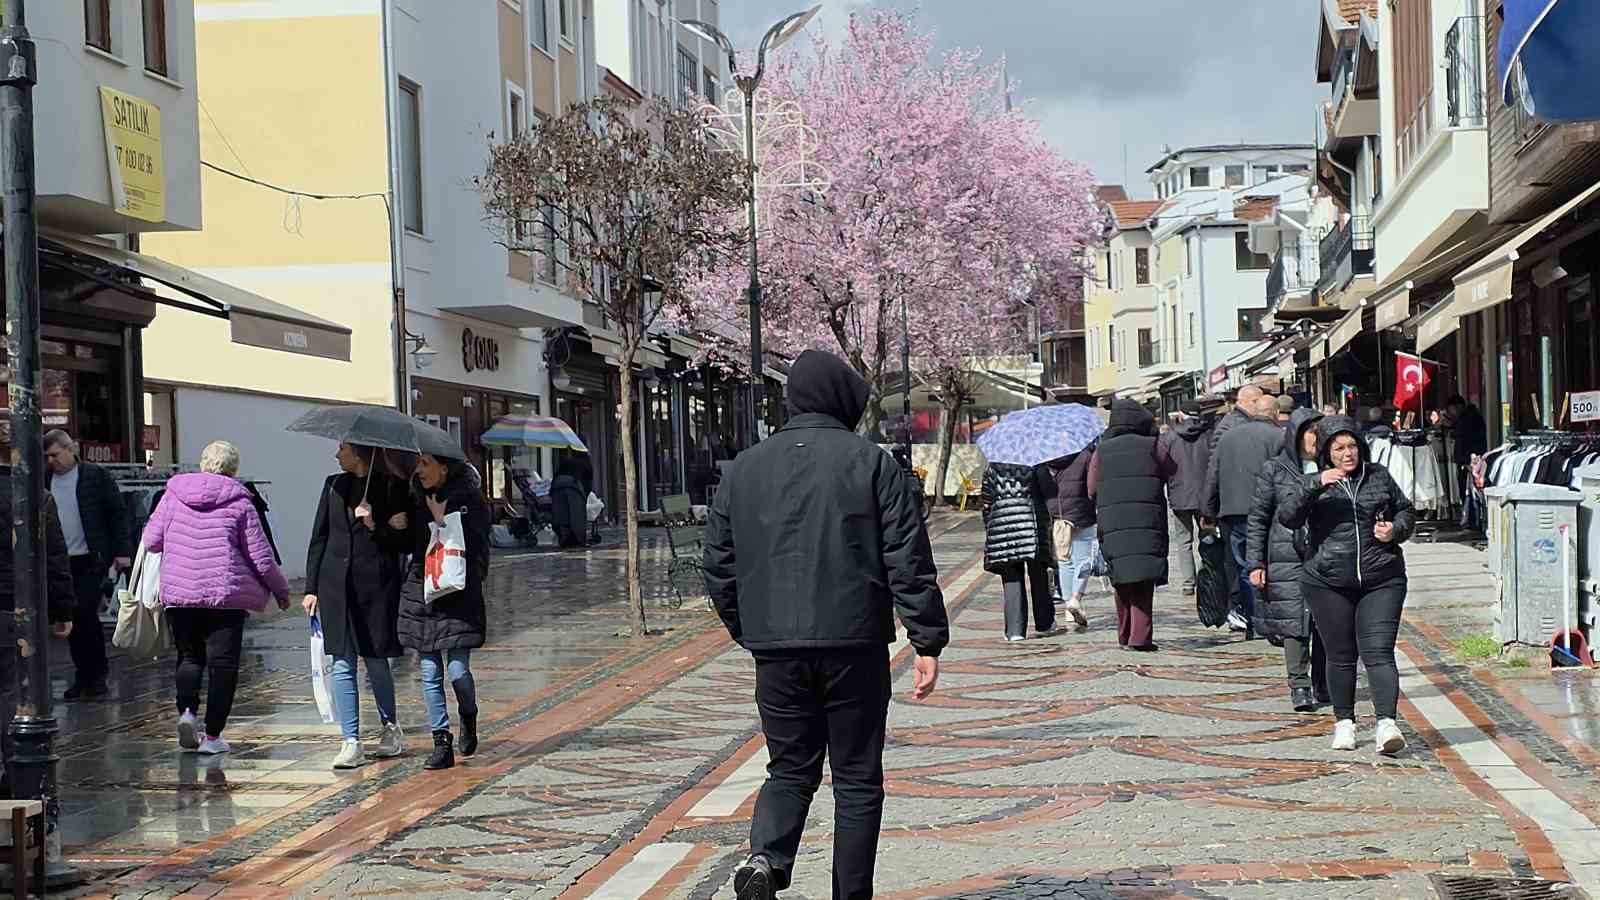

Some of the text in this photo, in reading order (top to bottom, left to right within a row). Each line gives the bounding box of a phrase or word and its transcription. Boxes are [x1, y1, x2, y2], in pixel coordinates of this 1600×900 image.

[114, 95, 149, 136] SATILIK
[1573, 402, 1592, 414] 500
[87, 446, 111, 461] 400
